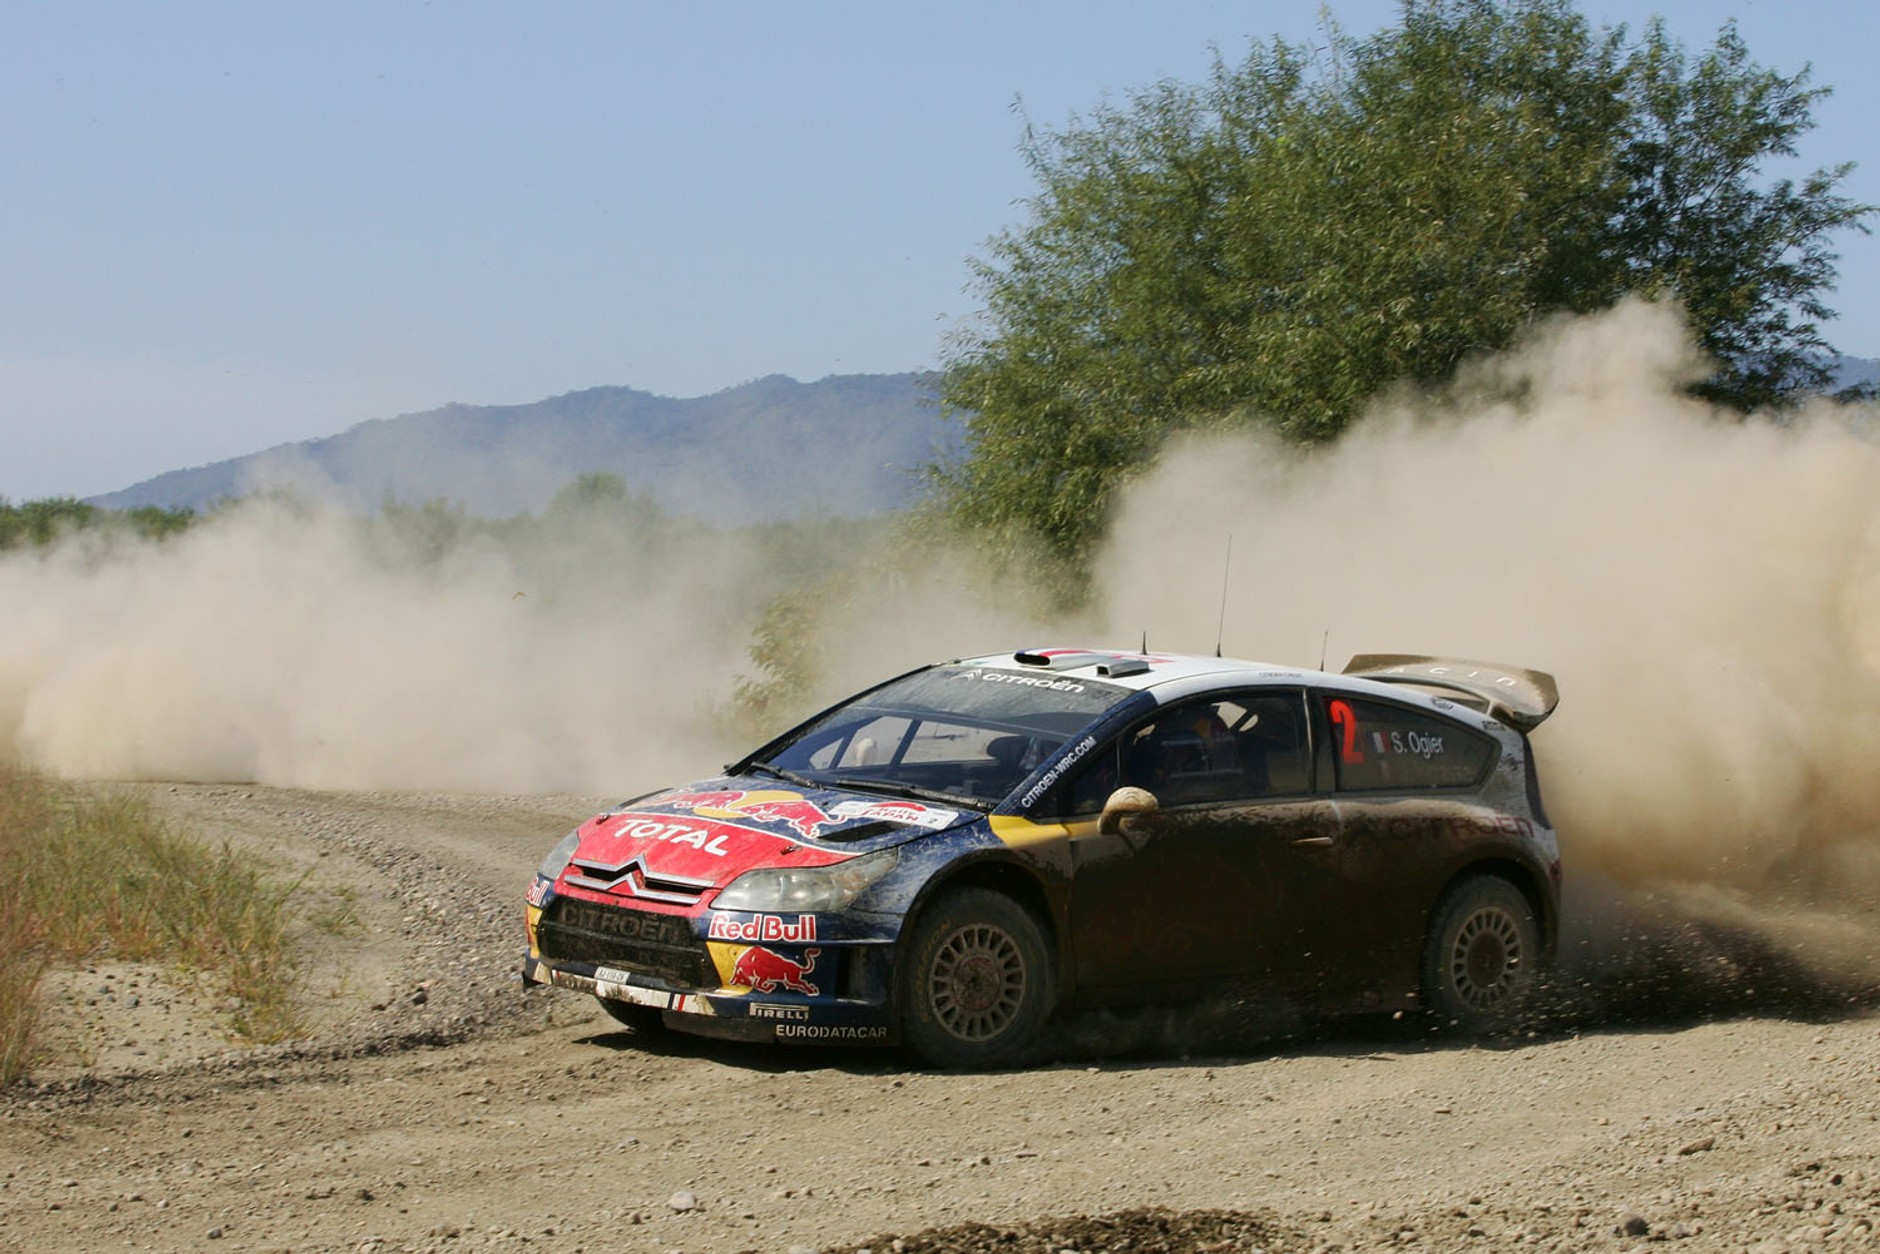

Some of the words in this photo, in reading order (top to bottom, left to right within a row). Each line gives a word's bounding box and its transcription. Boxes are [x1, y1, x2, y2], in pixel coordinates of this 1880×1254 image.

[1329, 700, 1365, 763] 2
[1391, 732, 1408, 753] S.
[1408, 732, 1444, 759] Ogier
[1021, 736, 1097, 808] CITROEN-WRC.COM
[614, 819, 729, 857] TOTAL
[709, 912, 762, 940] Red
[762, 915, 817, 941] Bull
[750, 1002, 809, 1021] PIRELLI
[776, 1024, 887, 1039] EURODATACAR
